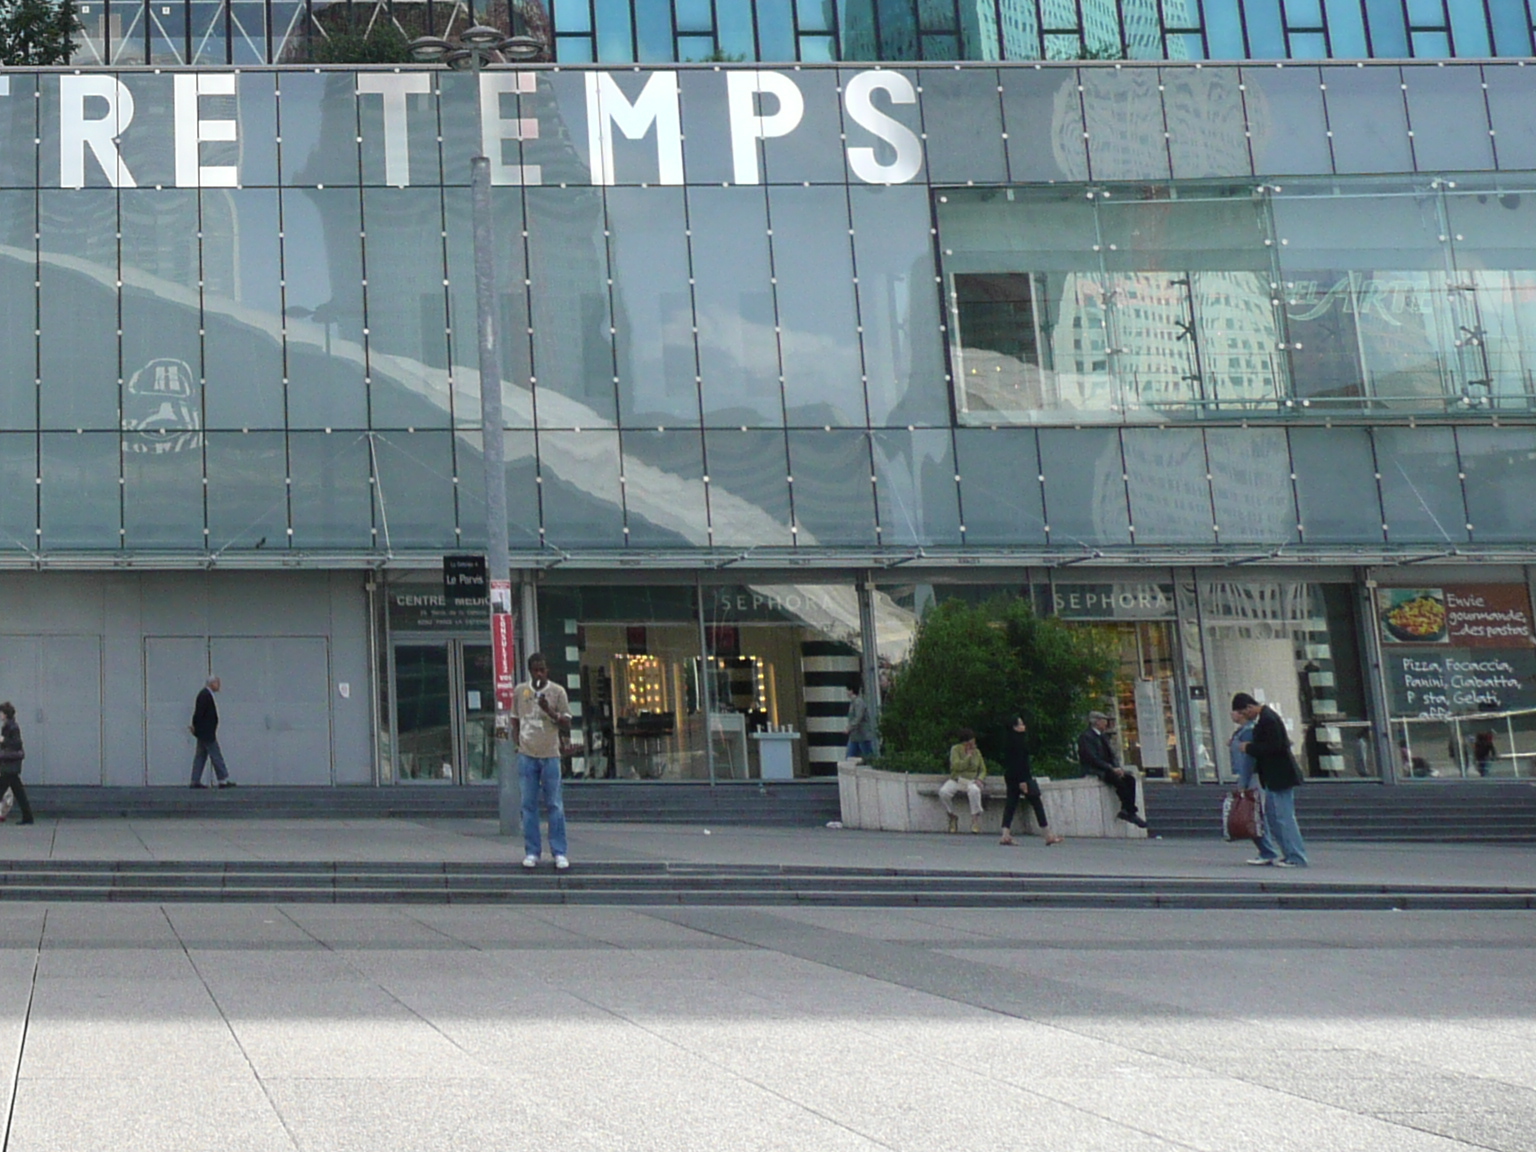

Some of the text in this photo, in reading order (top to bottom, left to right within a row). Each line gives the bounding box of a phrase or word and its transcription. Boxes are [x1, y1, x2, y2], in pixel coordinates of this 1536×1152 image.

[357, 69, 924, 188] TEMPS
[396, 594, 446, 607] CENTRE
[720, 594, 833, 611] SEPHORA
[1054, 592, 1168, 609] SEPHORA
[1446, 592, 1485, 608] Envie
[1486, 625, 1529, 638] pastas
[1402, 657, 1514, 674] Pizza, Focaccia,
[1404, 674, 1523, 690] Panini, Ciabatta,
[1406, 691, 1450, 706] Psta,
